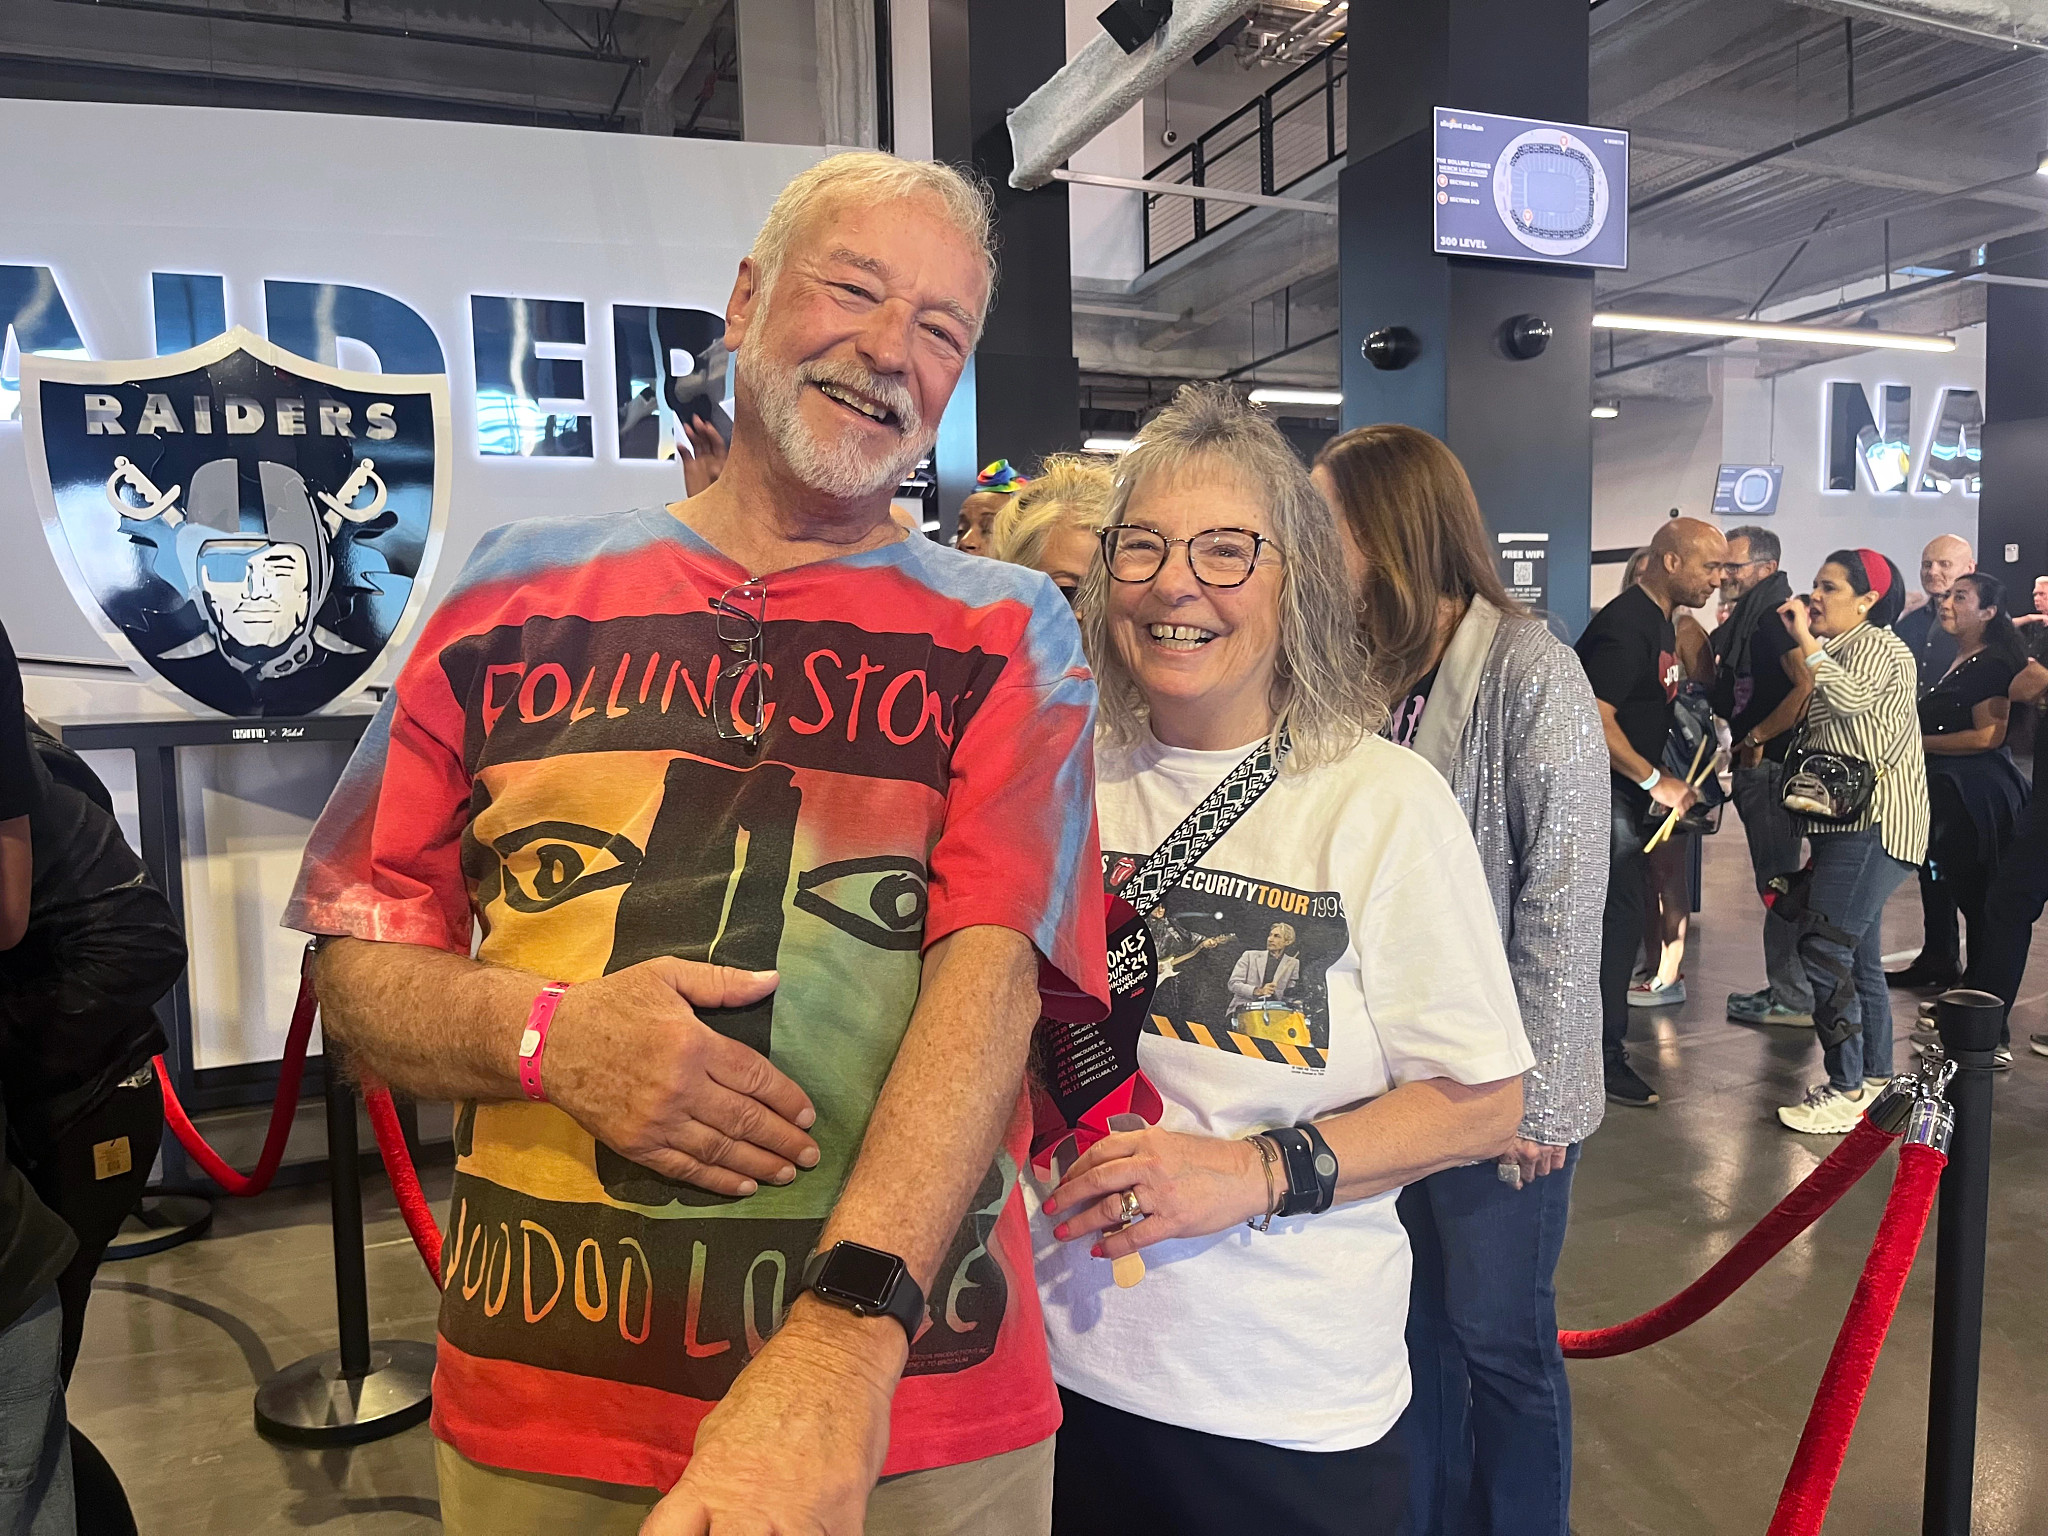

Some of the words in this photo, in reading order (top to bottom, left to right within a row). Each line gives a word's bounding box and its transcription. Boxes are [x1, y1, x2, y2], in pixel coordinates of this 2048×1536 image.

[1440, 236, 1458, 247] 300
[1459, 237, 1487, 249] LEVEL
[84, 393, 397, 440] RAIDERS
[1502, 550, 1524, 559] FREE
[1525, 550, 1545, 559] WIFI
[482, 651, 774, 738] ROLLING
[1177, 869, 1259, 903] ECURITY
[1117, 970, 1148, 995] DIAMONDS
[1074, 1060, 1084, 1069] LOS
[1077, 1069, 1087, 1078] LOS
[1080, 1075, 1096, 1087] SANTA
[442, 1197, 653, 1345] VOODOO
